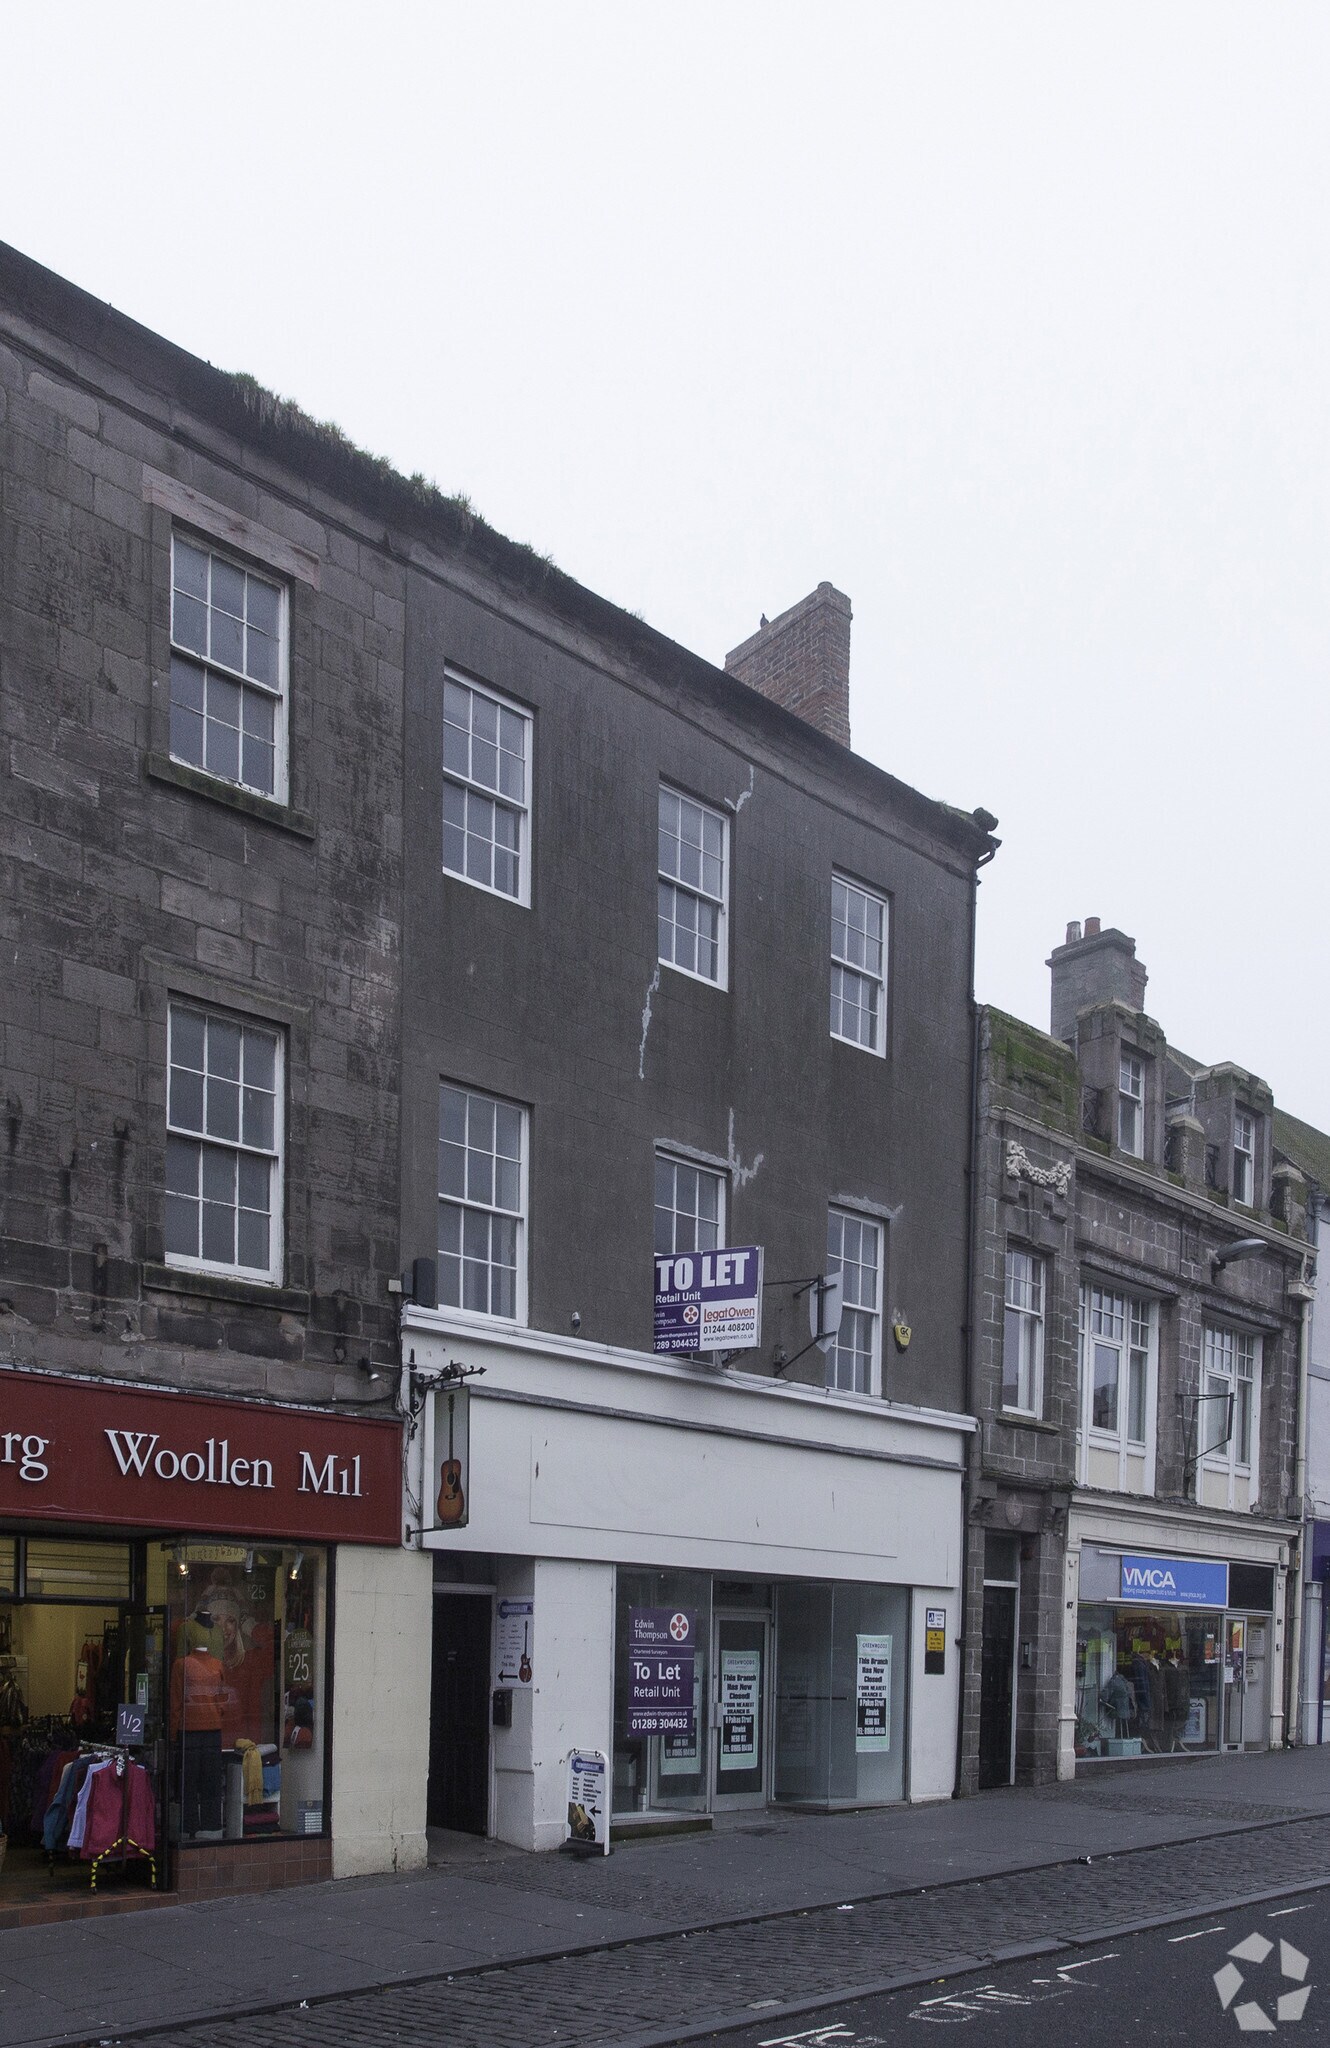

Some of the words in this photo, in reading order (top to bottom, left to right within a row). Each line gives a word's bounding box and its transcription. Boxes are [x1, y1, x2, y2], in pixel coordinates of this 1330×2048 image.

[656, 1257, 694, 1292] TO
[701, 1252, 750, 1288] LET
[656, 1293, 680, 1304] Retail
[682, 1292, 701, 1301] Unit
[654, 1318, 676, 1327] ompson
[703, 1324, 725, 1334] 01244
[727, 1322, 754, 1332] 408200
[654, 1340, 669, 1350] 1289
[672, 1338, 698, 1348] 304432
[1, 1432, 50, 1482] rg
[104, 1429, 275, 1488] Woollen
[298, 1452, 362, 1497] Mil
[634, 1619, 654, 1629] Edwin
[634, 1630, 668, 1642] Thompson
[289, 1653, 309, 1681] £25
[634, 1662, 650, 1680] To
[658, 1662, 681, 1680] Let
[724, 1674, 736, 1682] This
[737, 1674, 756, 1682] Branch
[634, 1686, 659, 1697] Retail
[662, 1686, 680, 1697] Unit
[120, 1711, 141, 1732] 1/2
[632, 1719, 657, 1730] 01289
[659, 1718, 688, 1729] 304432
